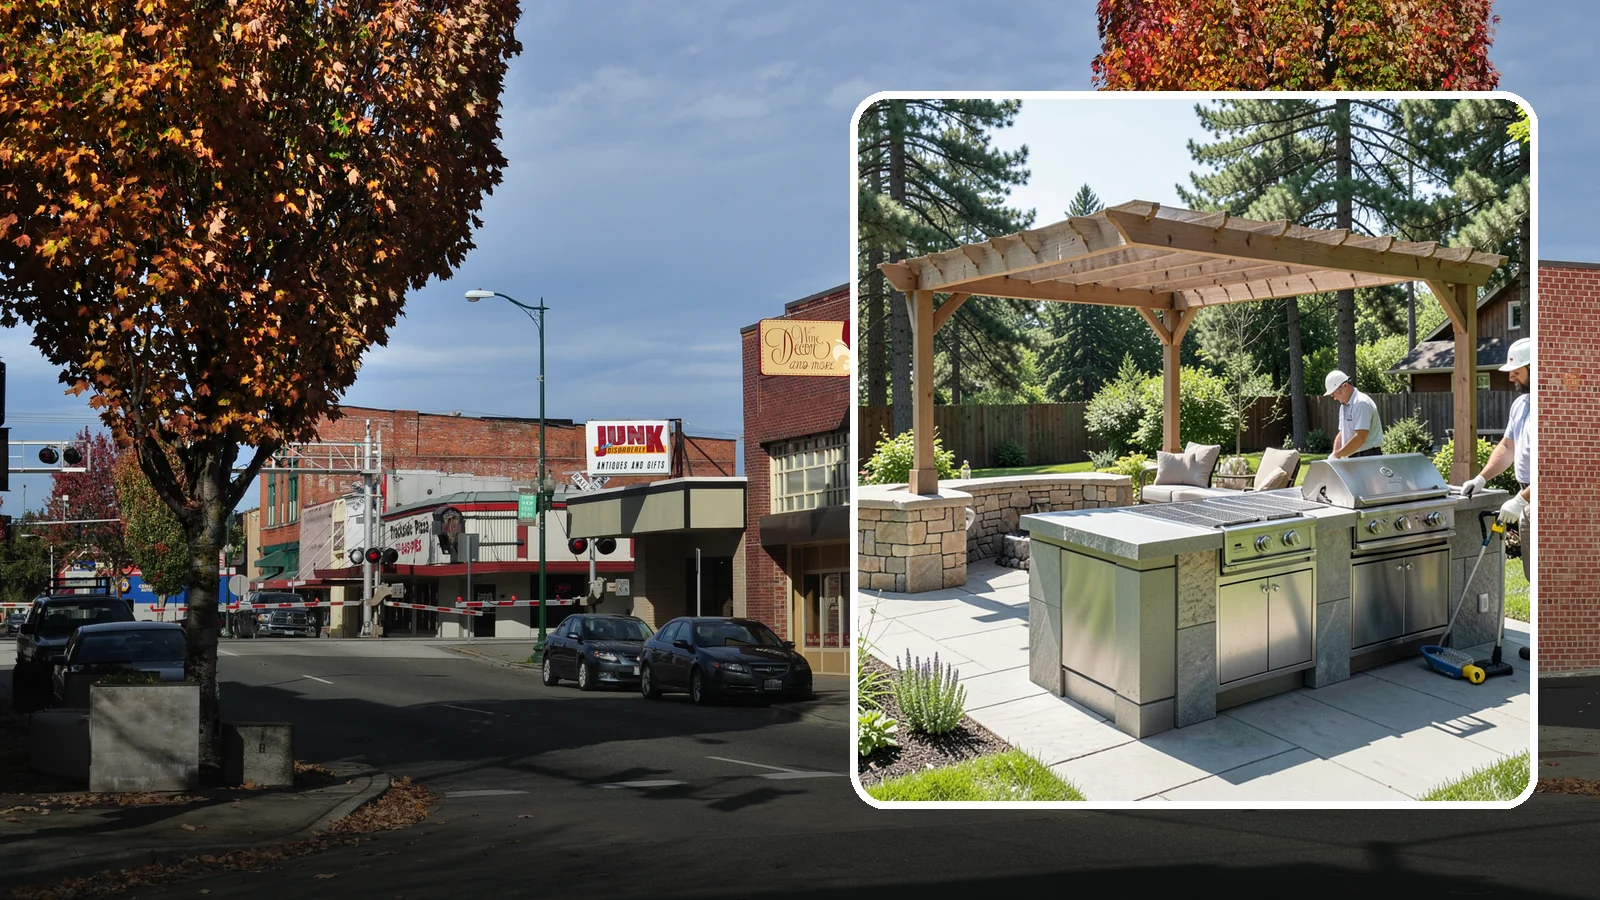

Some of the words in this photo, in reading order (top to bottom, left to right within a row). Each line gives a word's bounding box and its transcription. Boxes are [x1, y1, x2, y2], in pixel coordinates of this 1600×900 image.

[596, 425, 665, 457] JUNK
[607, 446, 645, 454] DISORDERLY
[597, 461, 628, 470] ANTIQUES
[631, 461, 644, 469] AND
[647, 460, 665, 469] GIFTS
[352, 498, 365, 510] CRO
